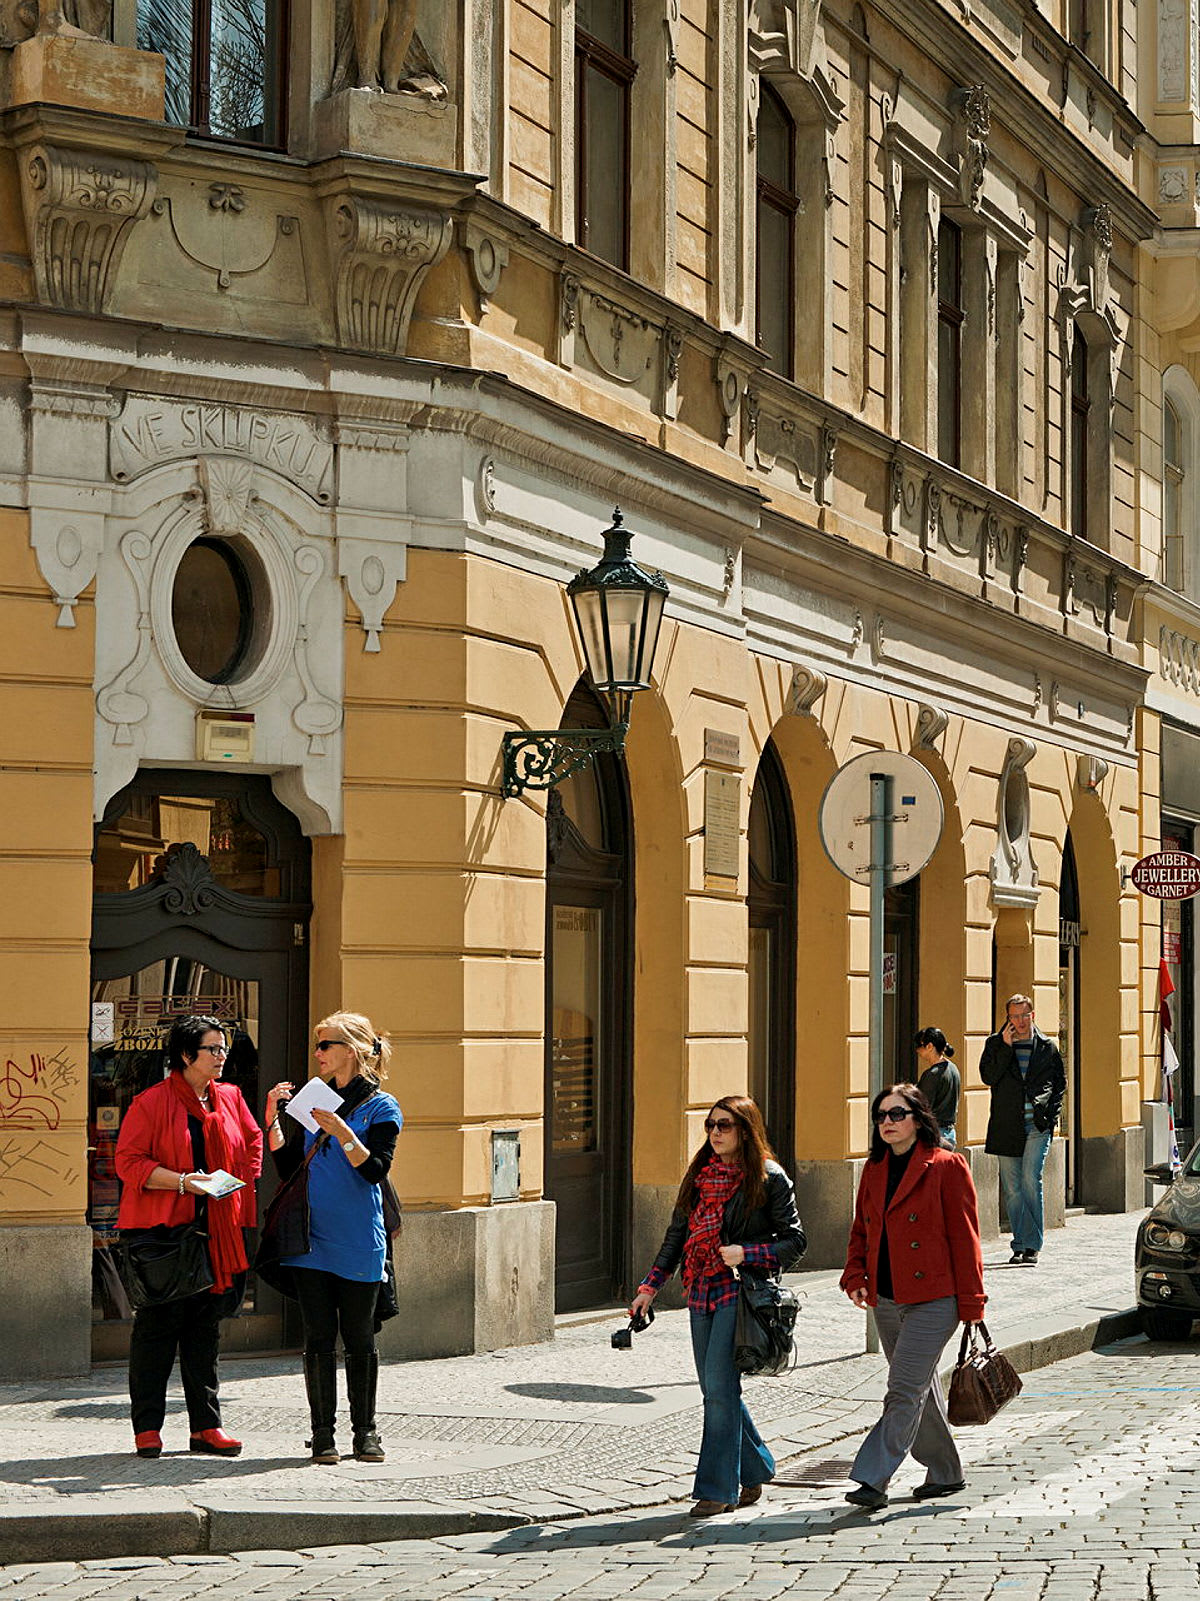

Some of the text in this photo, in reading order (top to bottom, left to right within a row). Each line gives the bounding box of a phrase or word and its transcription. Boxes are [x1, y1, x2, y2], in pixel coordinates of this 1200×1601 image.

[122, 411, 173, 460] VE
[1148, 854, 1188, 867] AMBER
[1146, 884, 1189, 898] GARNET
